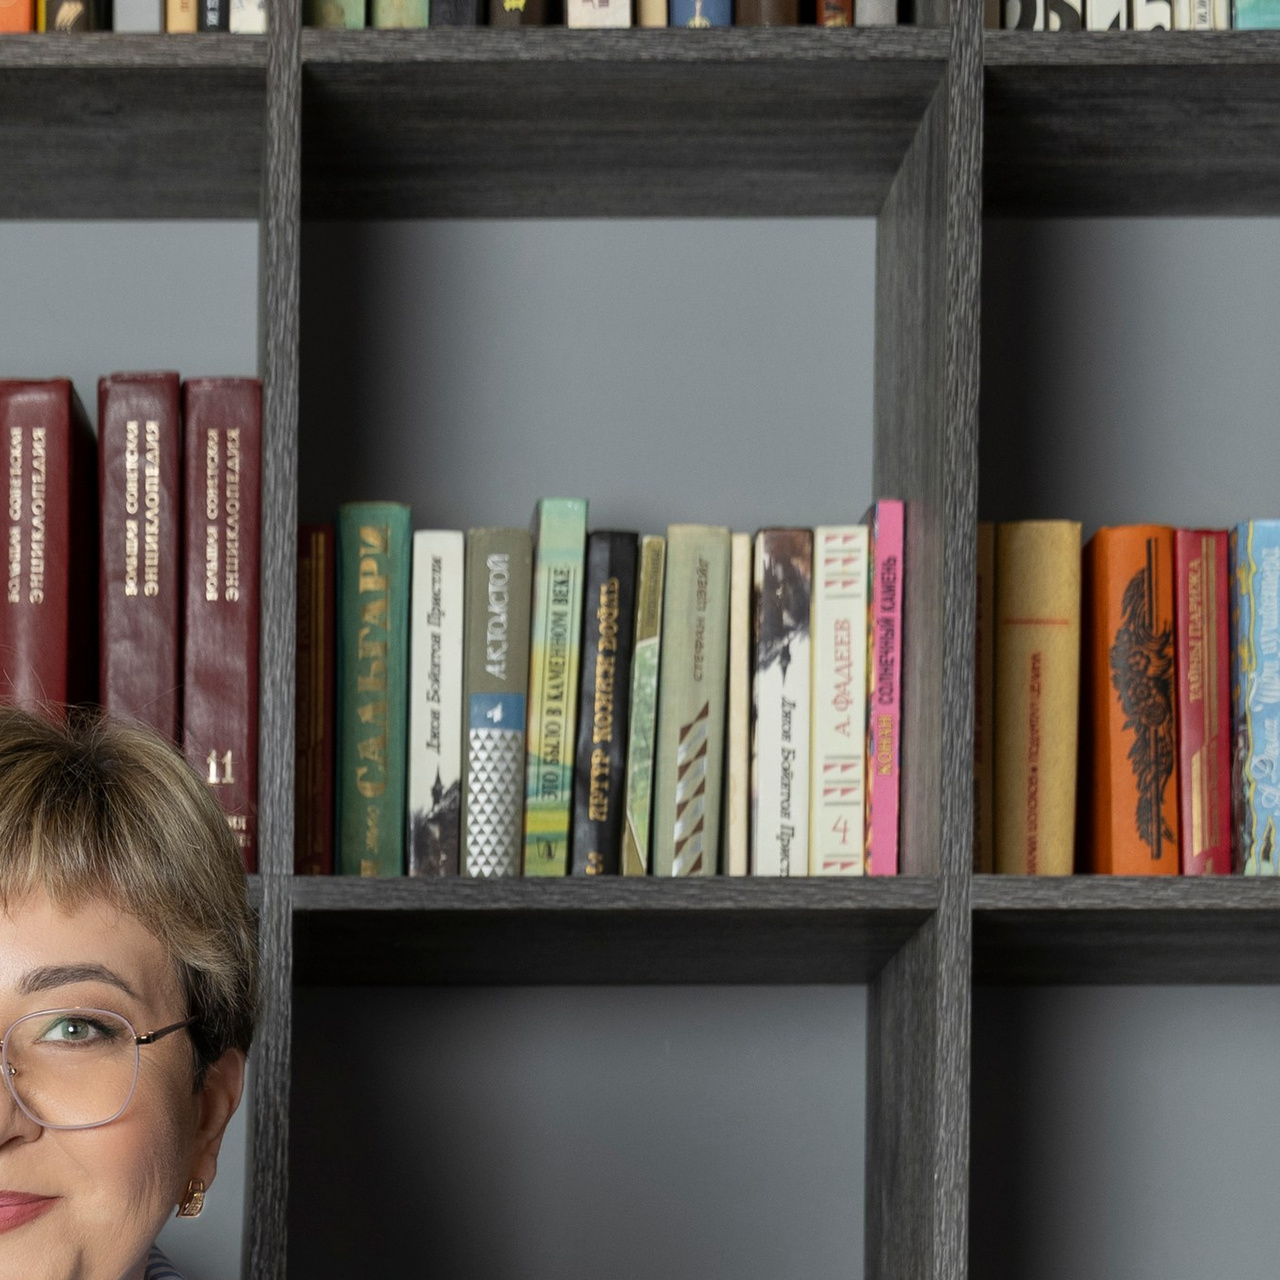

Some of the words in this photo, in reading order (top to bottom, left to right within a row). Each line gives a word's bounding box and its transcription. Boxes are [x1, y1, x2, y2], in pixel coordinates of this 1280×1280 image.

[427, 556, 445, 626] Пристли
[553, 567, 571, 604] ВЕКЕ
[595, 577, 619, 650] ДОЙЛЬ
[695, 555, 710, 611] ЦВЕЙГ
[878, 556, 897, 613] КАМЕНЬ
[1188, 558, 1203, 638] ПАРИЖА
[357, 524, 391, 797] САЛЬГАРИ
[427, 633, 441, 704] Бойнтон
[546, 609, 568, 701] КАМЕННОМ
[693, 617, 707, 682] СТЕФАН
[833, 618, 854, 712] ФАДЕЕВ
[877, 618, 896, 705] СОЛНЕЧНЫЙ
[1189, 641, 1202, 702] ТАЙНЫ
[546, 706, 562, 718] В
[591, 654, 615, 743] КОНАН
[427, 710, 440, 755] Джон
[543, 723, 562, 766] БЫЛО
[877, 714, 894, 775] КОНАН
[206, 750, 235, 783] 11
[542, 773, 559, 801] ЭТО
[589, 750, 608, 821] АРТУР
[833, 814, 850, 846] 4
